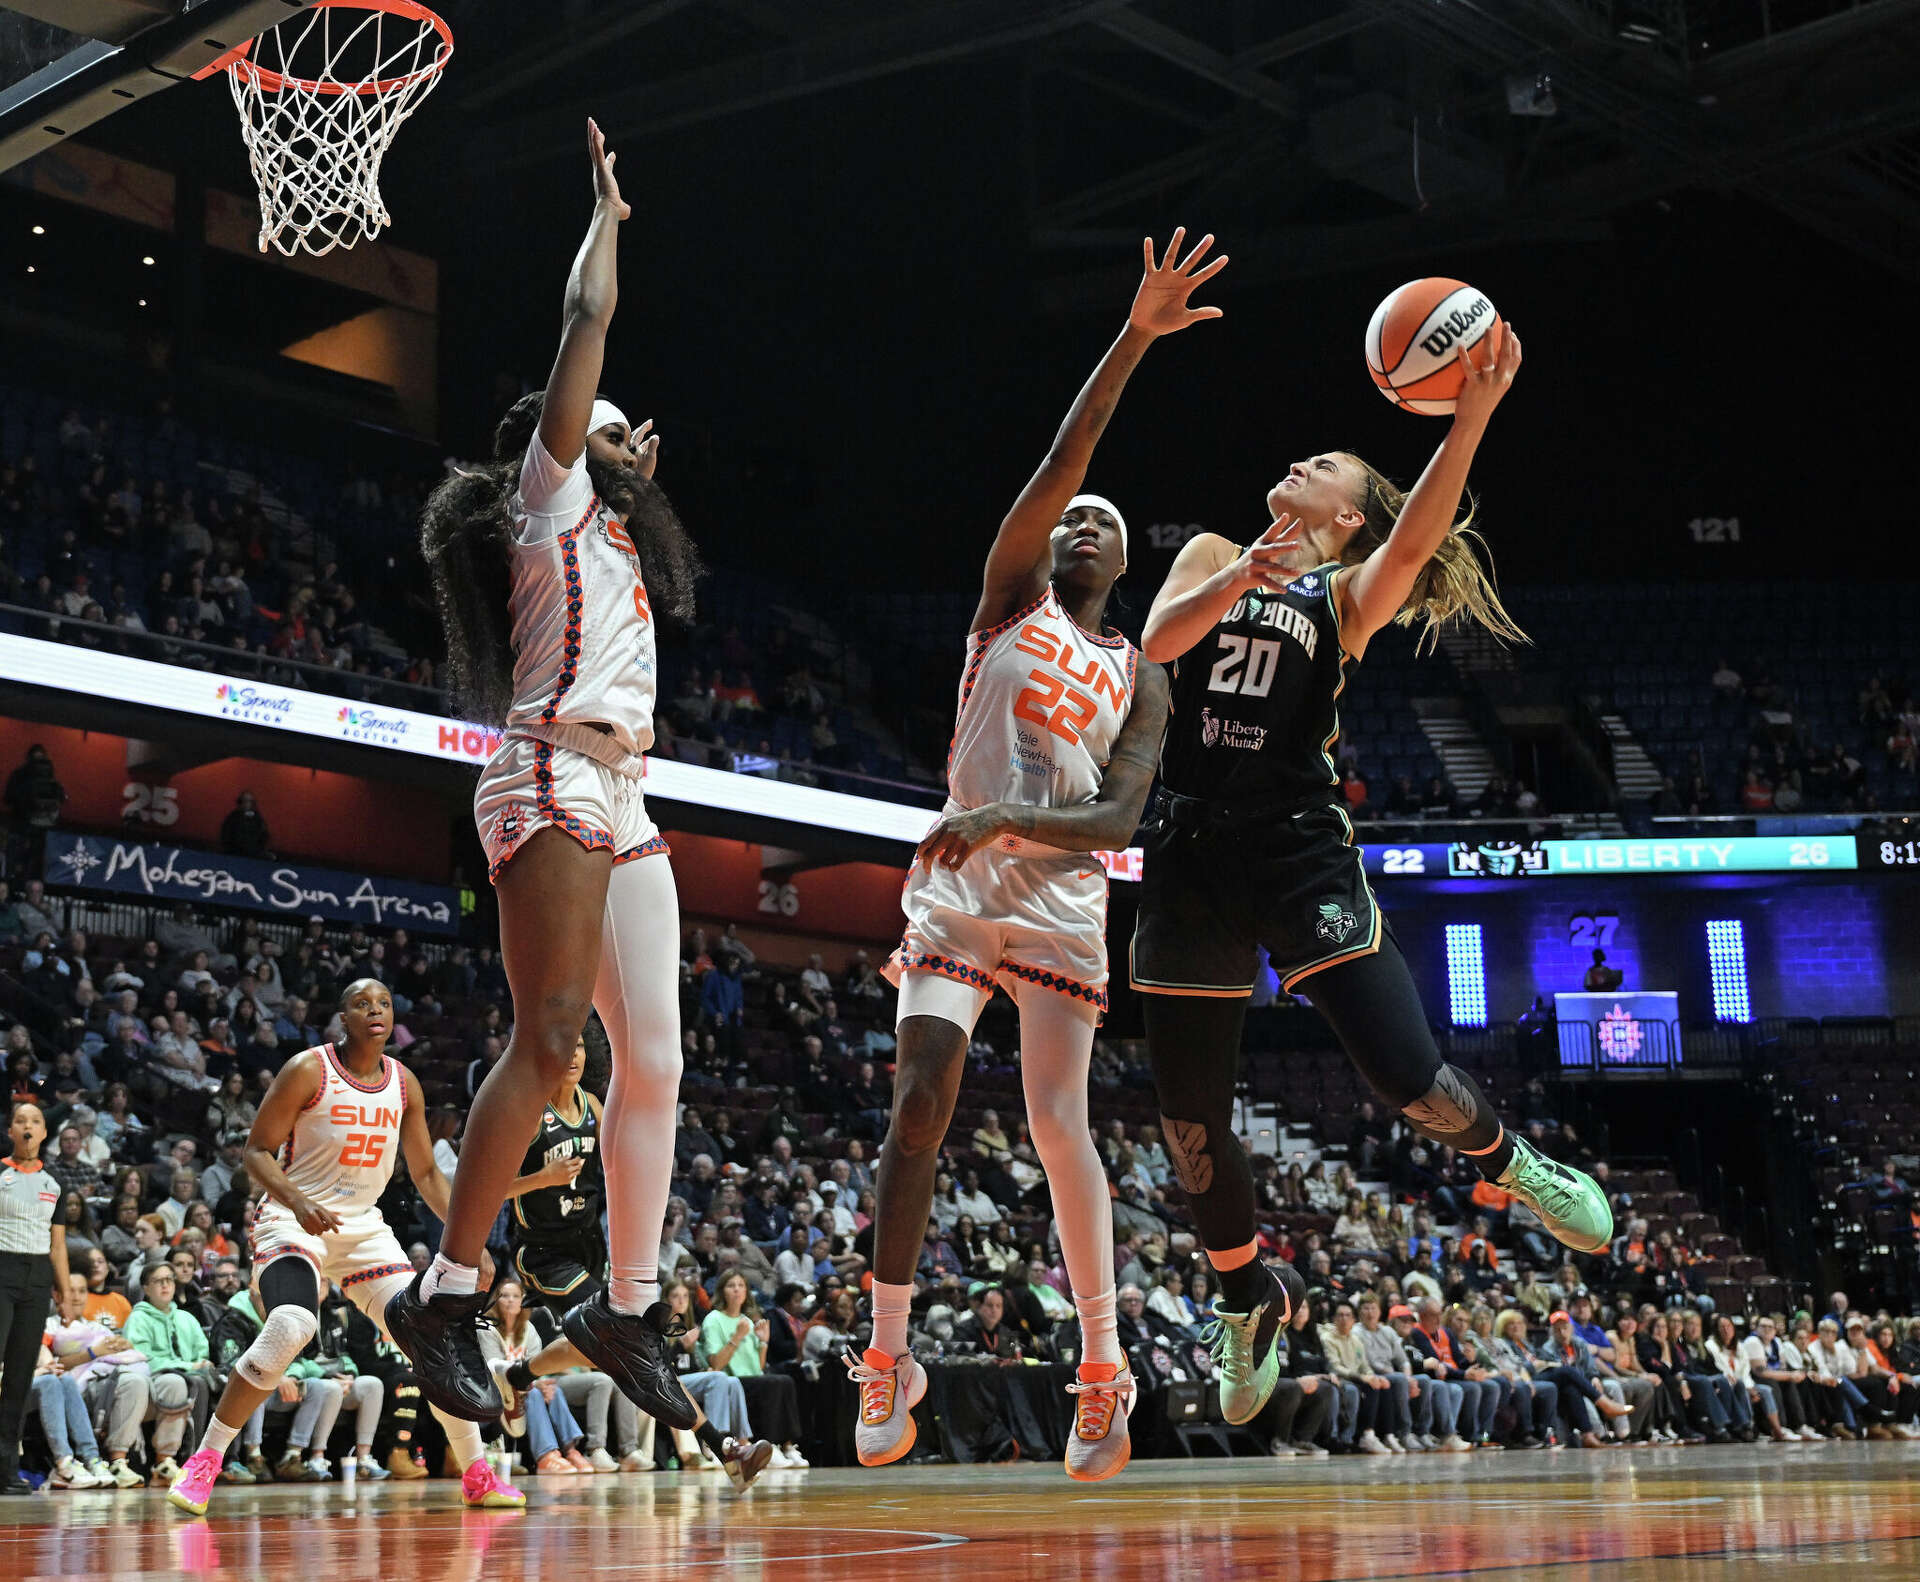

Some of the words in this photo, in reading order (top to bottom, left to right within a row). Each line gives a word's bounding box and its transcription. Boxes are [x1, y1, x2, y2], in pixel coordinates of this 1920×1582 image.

[1419, 298, 1490, 357] Wilson
[1688, 518, 1740, 541] 121
[1288, 583, 1325, 597] BARCLAYS
[1260, 601, 1319, 662] YORK
[1015, 624, 1126, 713] SUN
[1207, 632, 1282, 698] 20
[240, 687, 294, 712] Sports
[1013, 669, 1098, 746] 22
[222, 706, 283, 723] BOSTON
[359, 710, 408, 734] Sports
[343, 728, 399, 744] BOSTON
[1016, 728, 1039, 746] Yale
[1223, 719, 1267, 739] Liberty
[1221, 733, 1264, 751] Mutual
[1010, 755, 1047, 778] Health
[121, 782, 179, 826] 25
[1382, 849, 1425, 873] 22
[1560, 843, 1734, 869] LIBERTY
[1788, 843, 1829, 866] 26
[1880, 841, 1920, 865] 8:1
[105, 842, 264, 903] Mohegan
[268, 868, 340, 909] Sun
[345, 878, 451, 924] Arena
[757, 880, 799, 916] 26
[1570, 915, 1620, 946] 27
[330, 1104, 399, 1129] SUN
[338, 1133, 388, 1168] 25
